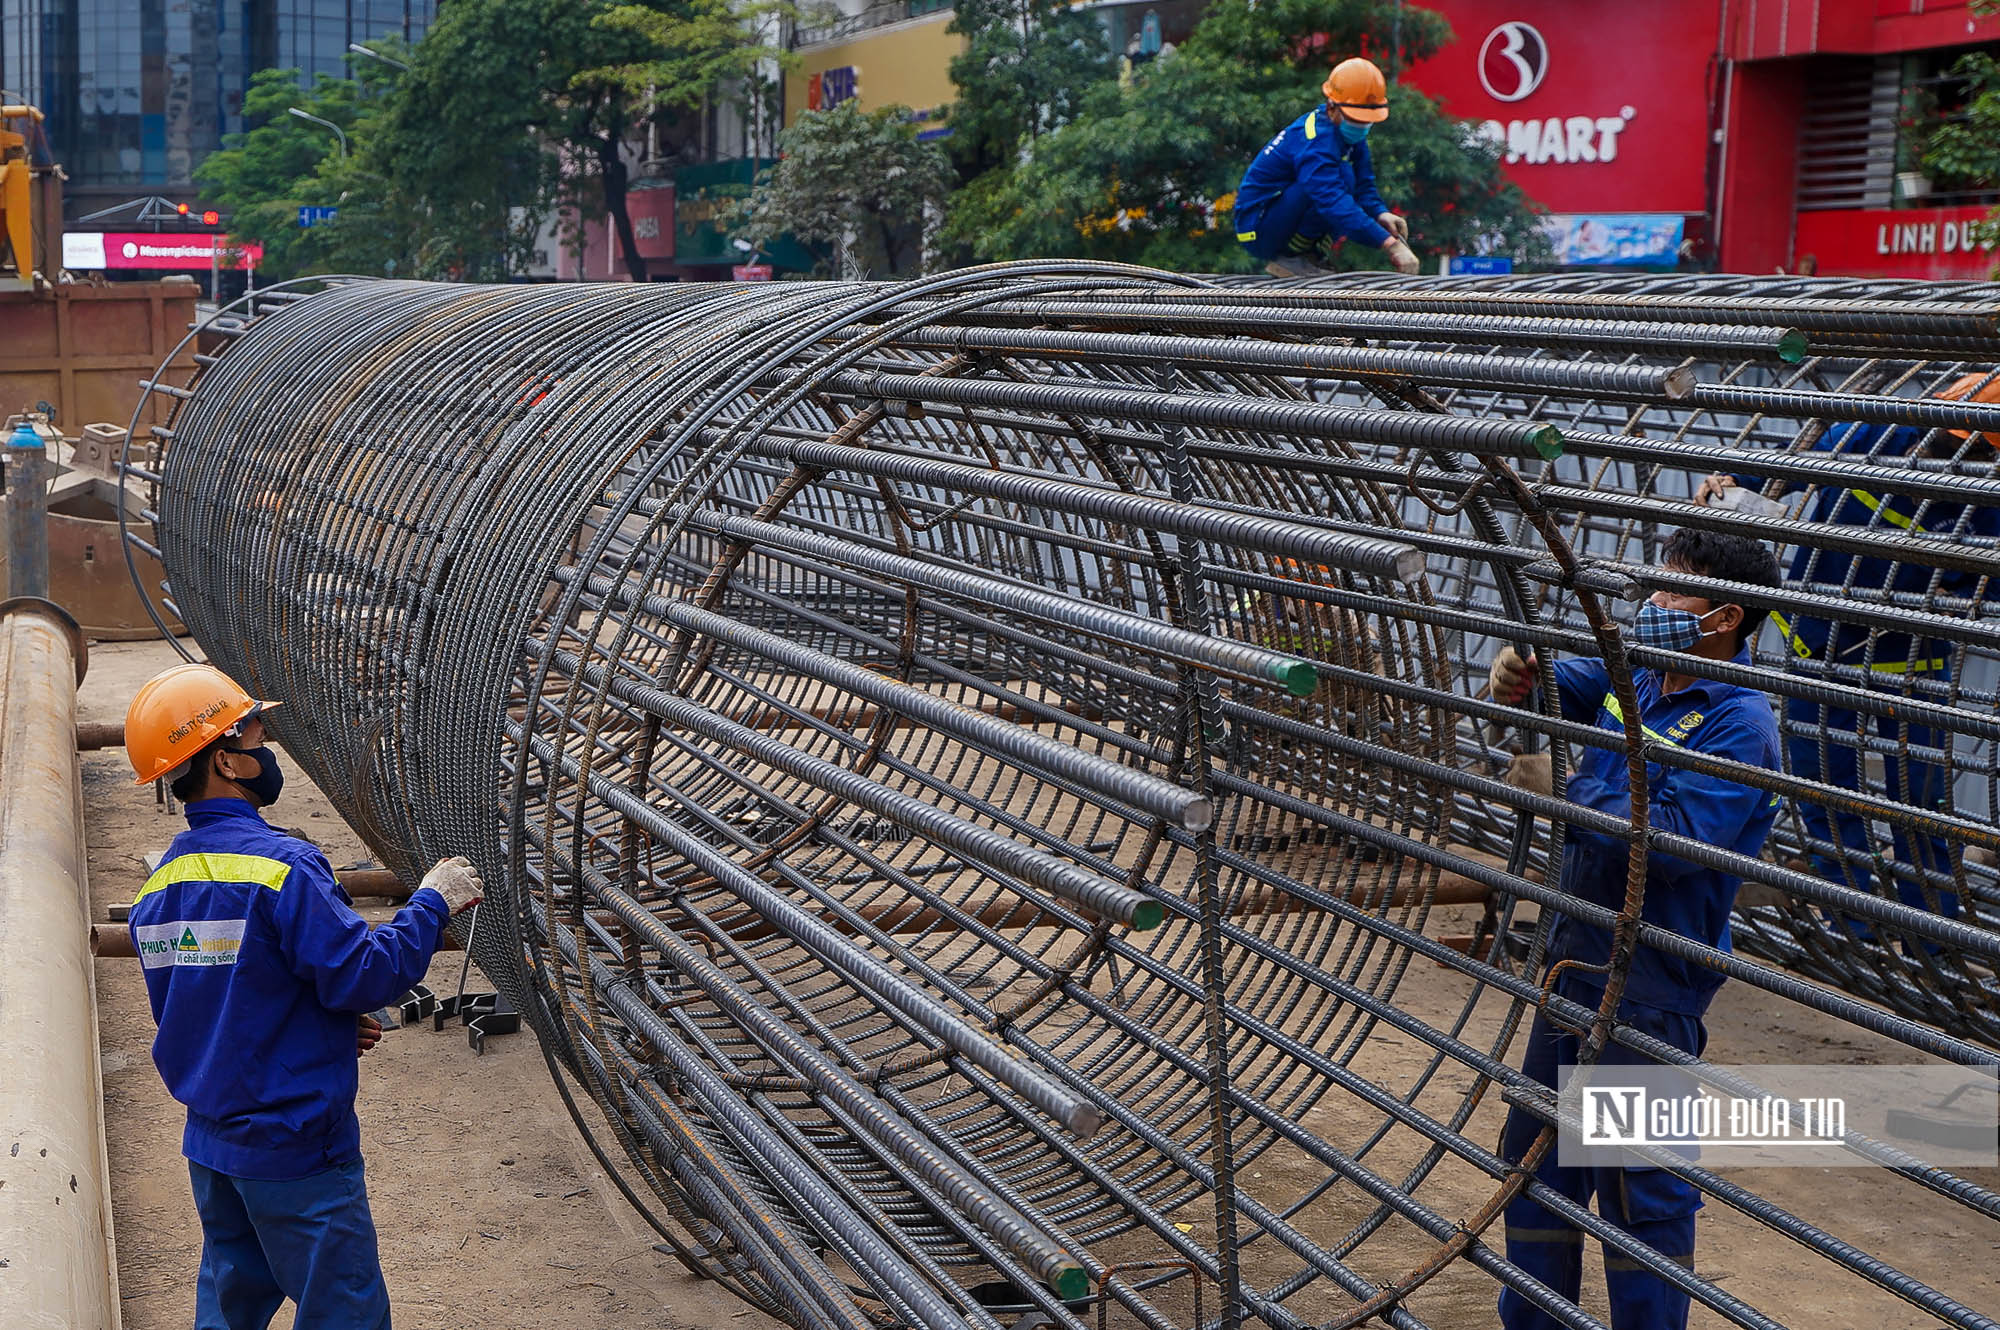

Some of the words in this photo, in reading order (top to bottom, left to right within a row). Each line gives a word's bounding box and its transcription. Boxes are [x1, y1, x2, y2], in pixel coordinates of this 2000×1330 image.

[1877, 222, 1937, 254] LINH
[186, 718, 199, 731] TY
[196, 712, 207, 725] CP
[218, 699, 229, 709] 12
